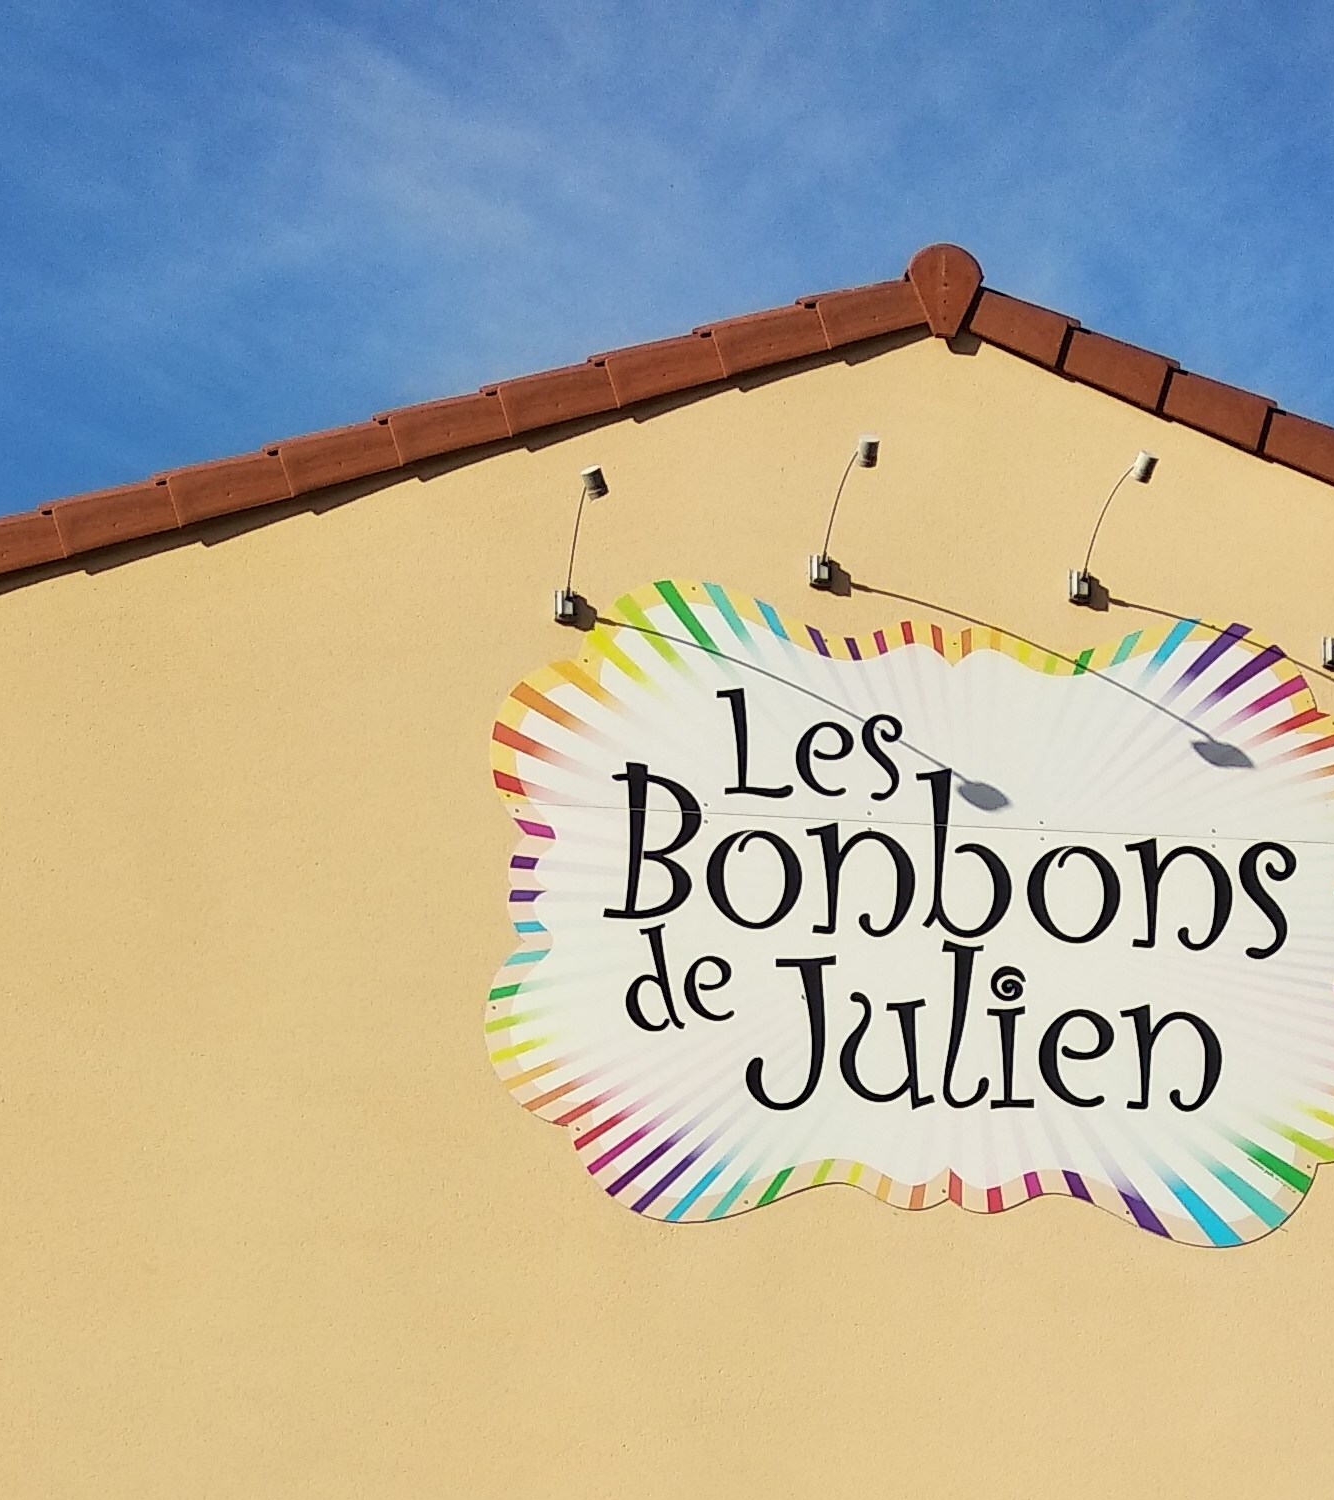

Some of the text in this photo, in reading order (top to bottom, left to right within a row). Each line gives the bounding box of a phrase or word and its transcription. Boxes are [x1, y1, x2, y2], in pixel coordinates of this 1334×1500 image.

[716, 688, 903, 801] Les
[603, 763, 1297, 960] Bonbons
[625, 924, 736, 1034] de
[745, 941, 1223, 1113] Julien
